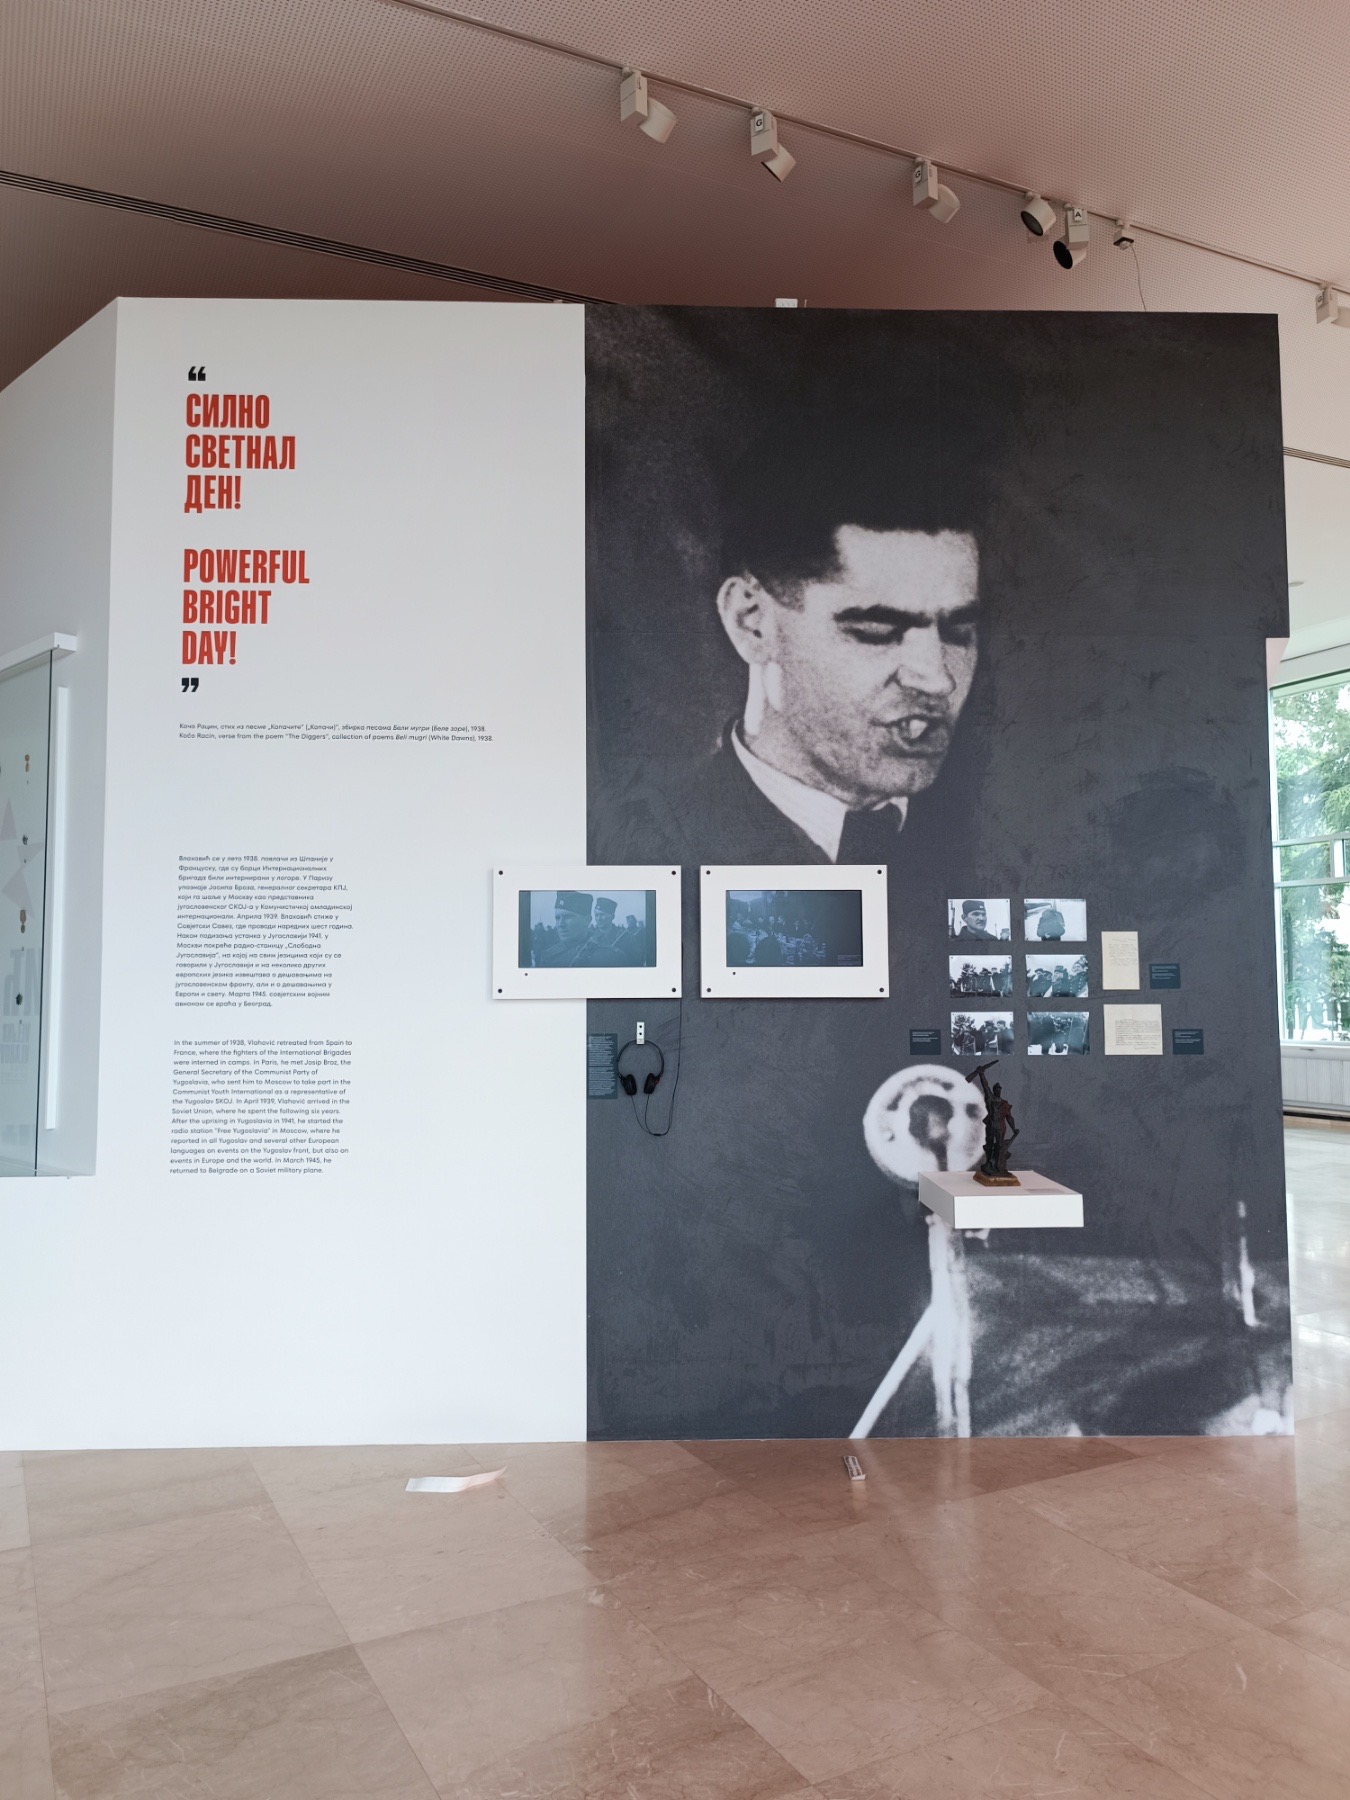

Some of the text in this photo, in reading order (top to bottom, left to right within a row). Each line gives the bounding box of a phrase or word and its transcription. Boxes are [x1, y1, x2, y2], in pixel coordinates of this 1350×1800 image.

[755, 118, 763, 127] G
[915, 170, 921, 179] G
[186, 393, 270, 429] СИЛНО
[185, 434, 296, 470] СВЕТНАЛ
[184, 474, 241, 513] ДЕН!
[183, 548, 310, 584] POWERFUL
[182, 589, 272, 625] BRIGHT
[181, 630, 237, 665] DAY!
[325, 1039, 345, 1047] Spain
[232, 1049, 259, 1057] fighters
[323, 1049, 352, 1058] Brigades
[172, 1068, 200, 1076] General
[200, 1068, 233, 1076] Secretary
[233, 1068, 241, 1076] of
[253, 1068, 292, 1076] Communist
[292, 1068, 311, 1076] Party
[310, 1068, 319, 1076] of
[289, 1088, 338, 1096] representative
[279, 1107, 310, 1116] following
[170, 1147, 206, 1156] languages
[262, 1147, 293, 1155] Yugoslav
[208, 1167, 239, 1175] Belgrade
[255, 1166, 277, 1174] Soviet
[277, 1167, 303, 1175] military
